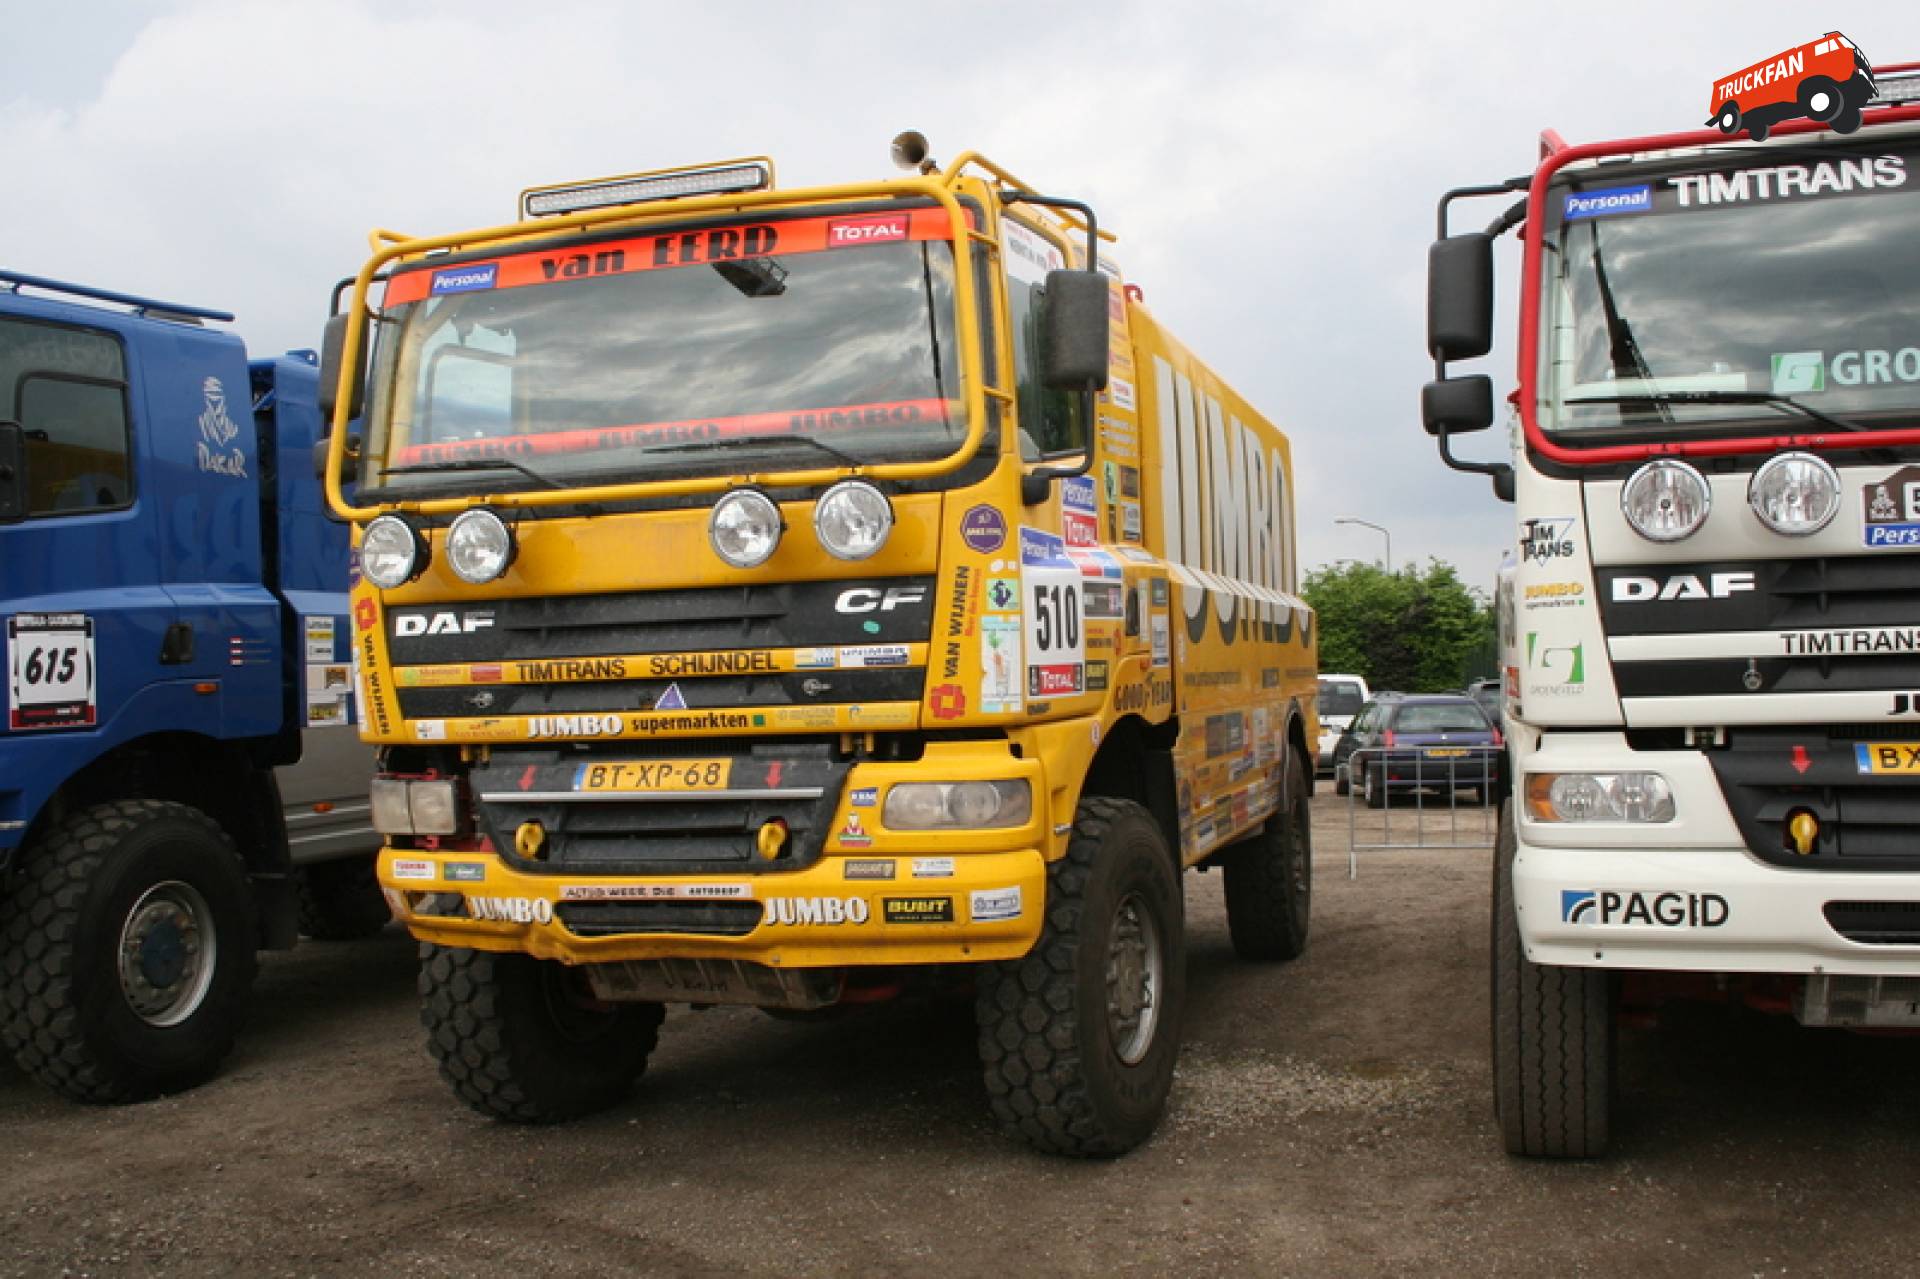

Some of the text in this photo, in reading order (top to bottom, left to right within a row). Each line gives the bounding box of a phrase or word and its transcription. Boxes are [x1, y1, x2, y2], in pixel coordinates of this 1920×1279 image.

[1667, 155, 1907, 207] TIMTRANS
[1566, 189, 1649, 213] Personal
[831, 223, 905, 241] TOTAL
[433, 266, 496, 290] Personal
[540, 249, 626, 280] van
[834, 586, 928, 614] CF
[1611, 571, 1756, 602] DAF
[394, 611, 496, 637] DAF
[1033, 584, 1079, 651] 510
[25, 647, 78, 685] 615
[516, 651, 780, 681] TIMTRANS SCHIJNDEL
[943, 642, 961, 679] VAN
[528, 712, 749, 738] JUMBO supermarkten
[588, 762, 722, 789] BT-XP-68
[762, 896, 870, 927] JUMBO
[1600, 892, 1729, 927] PAGID
